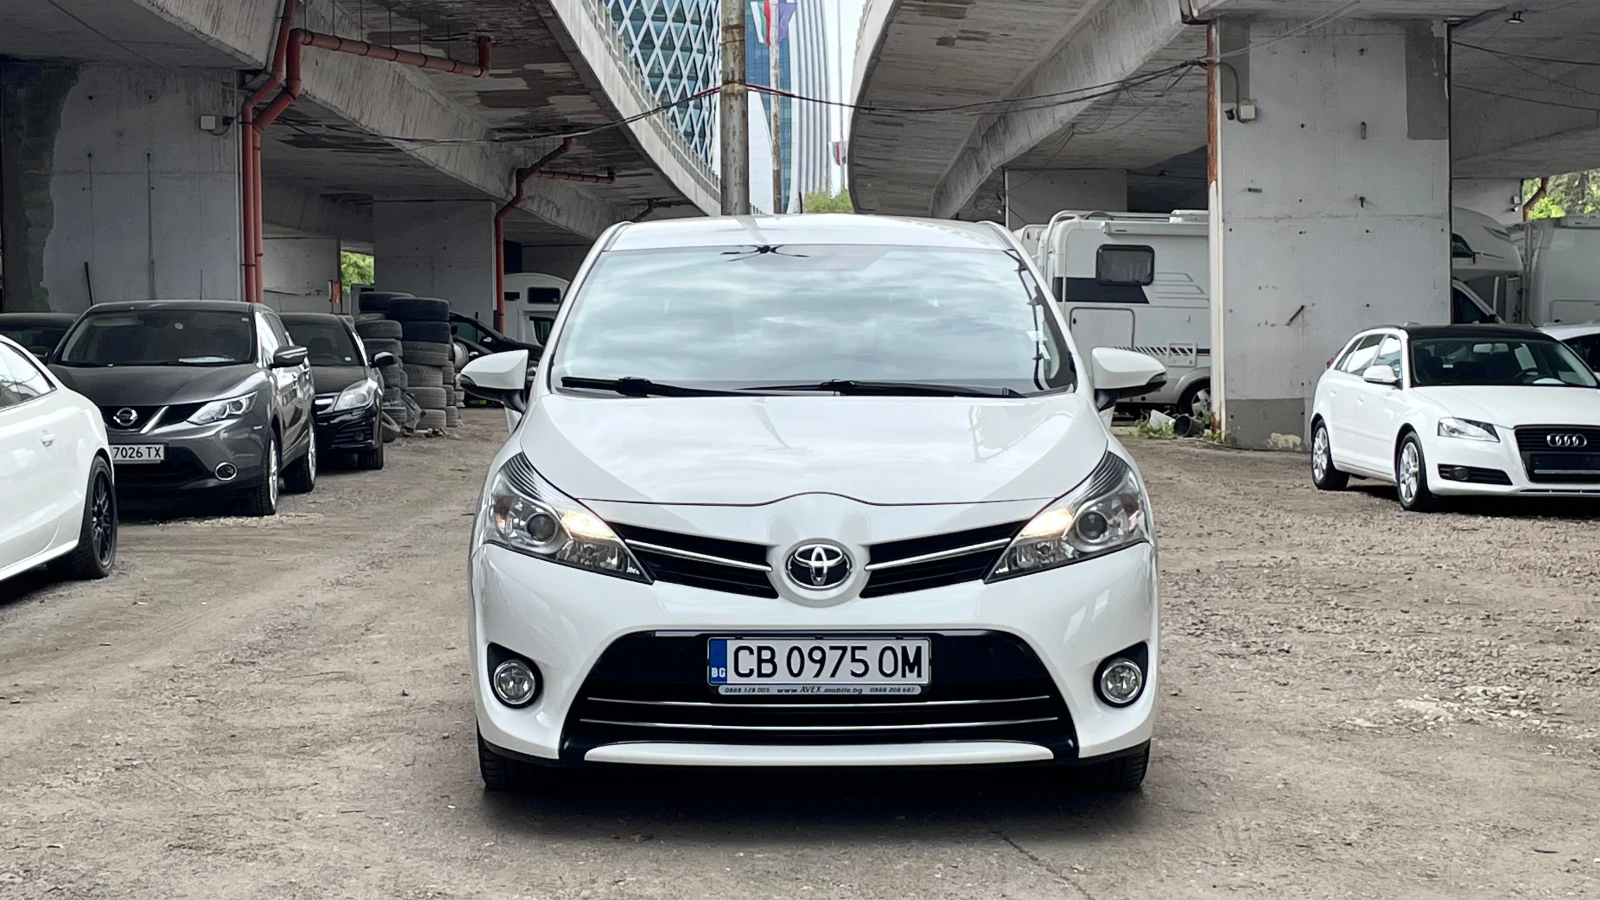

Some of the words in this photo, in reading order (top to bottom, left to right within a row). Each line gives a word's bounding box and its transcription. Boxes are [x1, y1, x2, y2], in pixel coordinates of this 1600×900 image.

[113, 447, 143, 459] 7026
[145, 447, 161, 458] TX
[733, 645, 778, 678] CB
[786, 645, 870, 678] 0975
[878, 645, 922, 678] OM
[711, 667, 726, 678] BG
